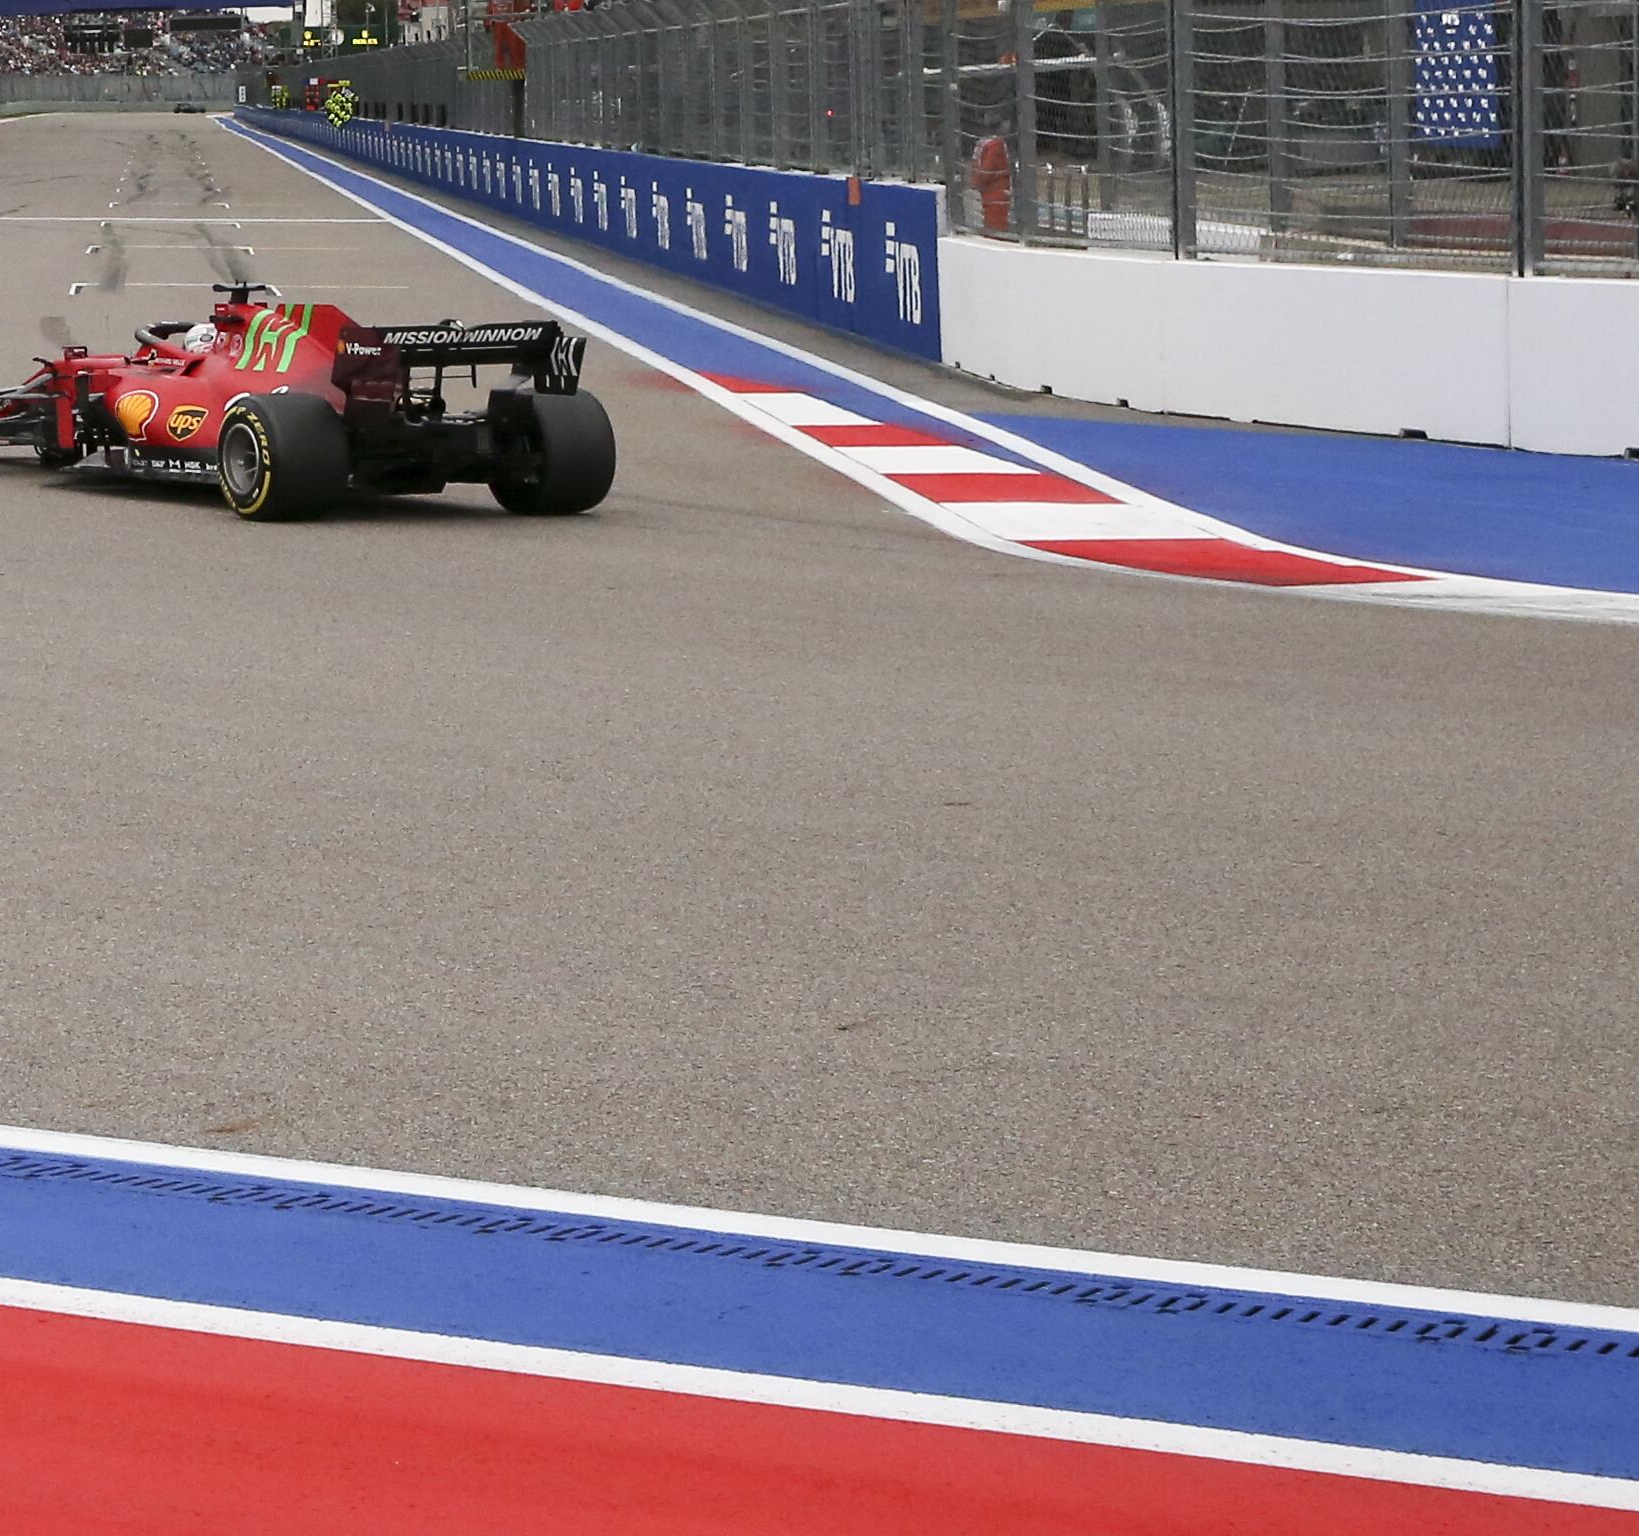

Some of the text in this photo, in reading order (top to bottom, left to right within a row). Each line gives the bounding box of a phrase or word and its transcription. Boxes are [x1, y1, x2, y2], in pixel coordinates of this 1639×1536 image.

[830, 227, 855, 303] VTB
[895, 241, 921, 325] VTB
[383, 327, 543, 345] MISSION WINNOW
[169, 413, 201, 432] ups
